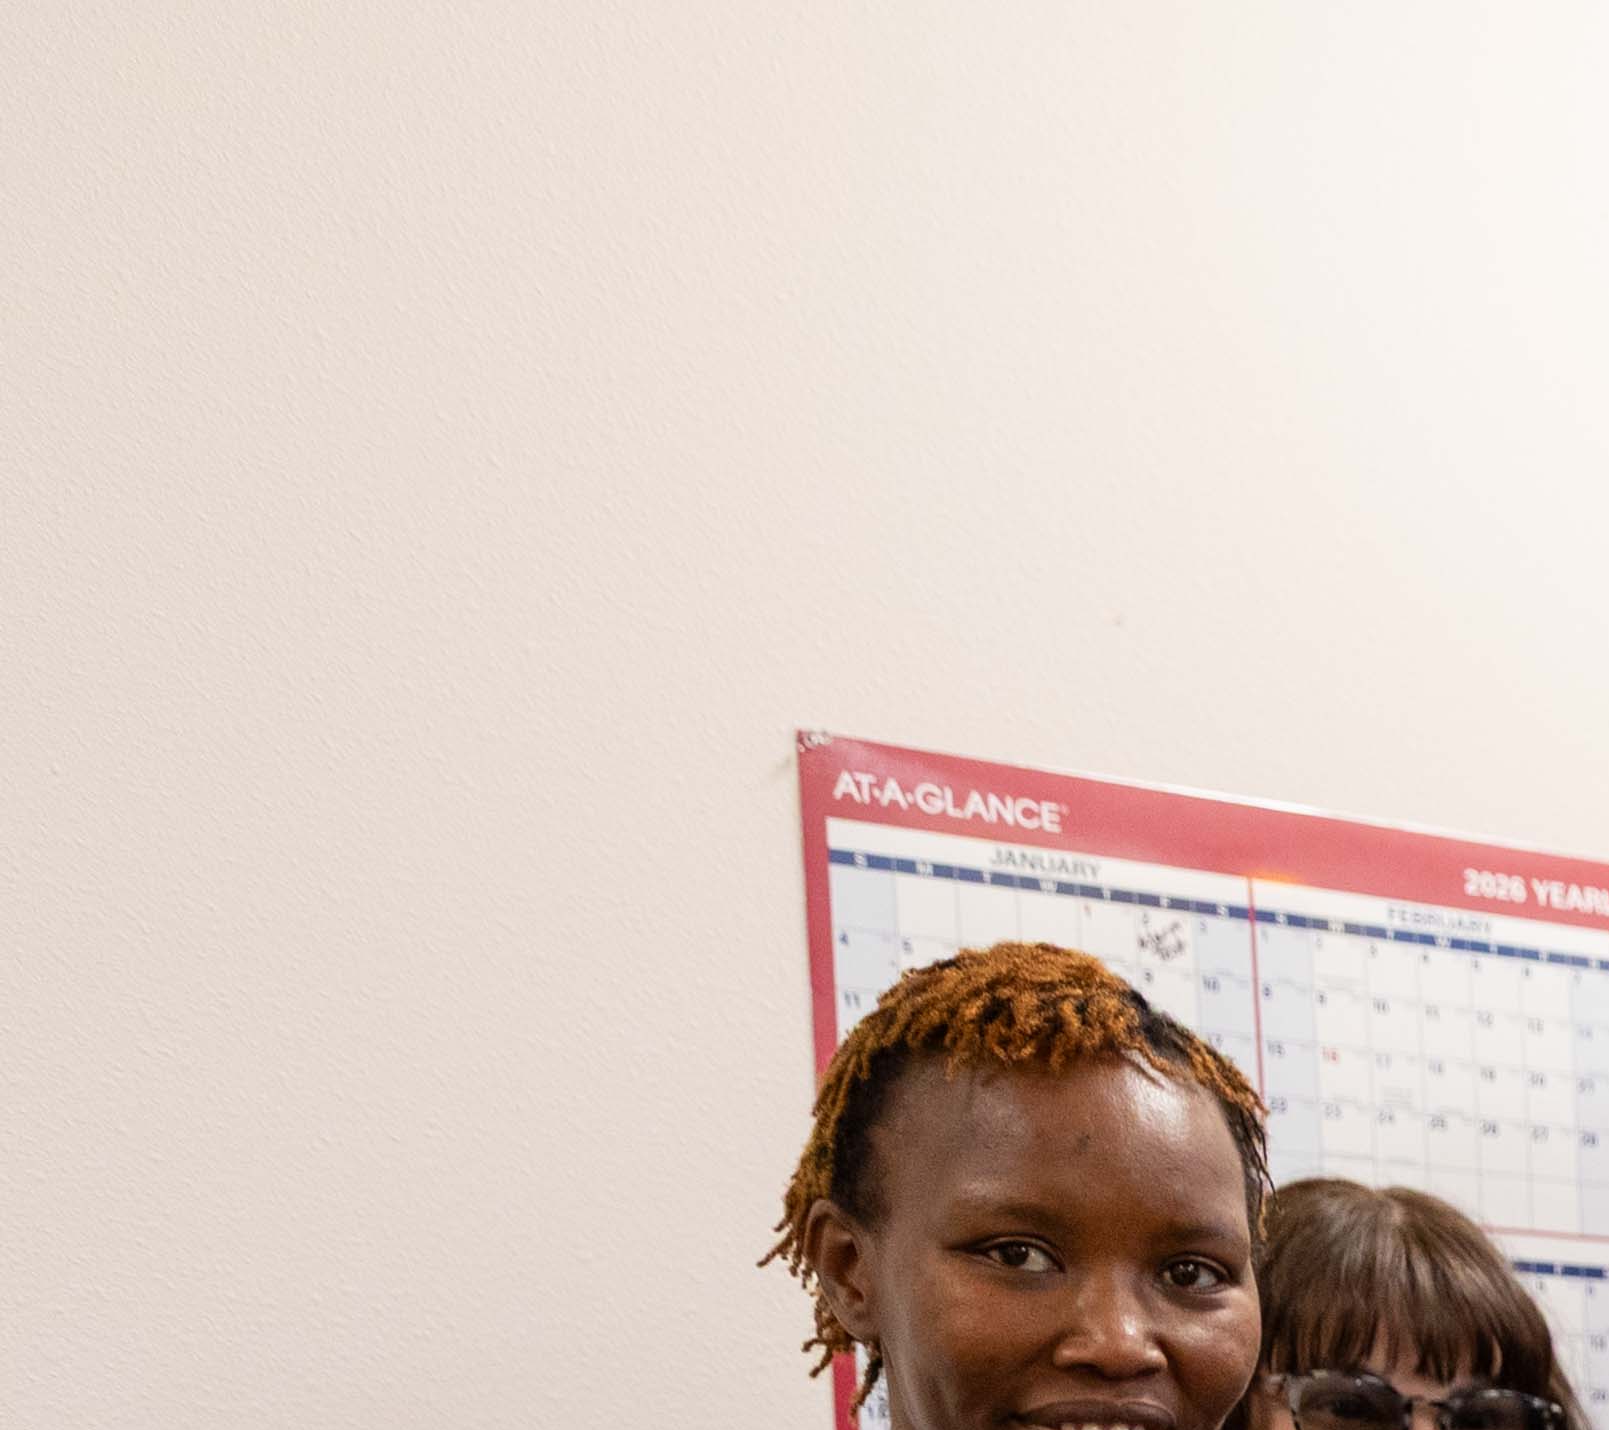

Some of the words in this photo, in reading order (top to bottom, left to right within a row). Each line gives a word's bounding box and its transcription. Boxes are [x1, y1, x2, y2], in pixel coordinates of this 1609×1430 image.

[989, 847, 1100, 879] JANUARY
[1463, 868, 1527, 904] 2026
[1387, 906, 1493, 933] FEBRUARY
